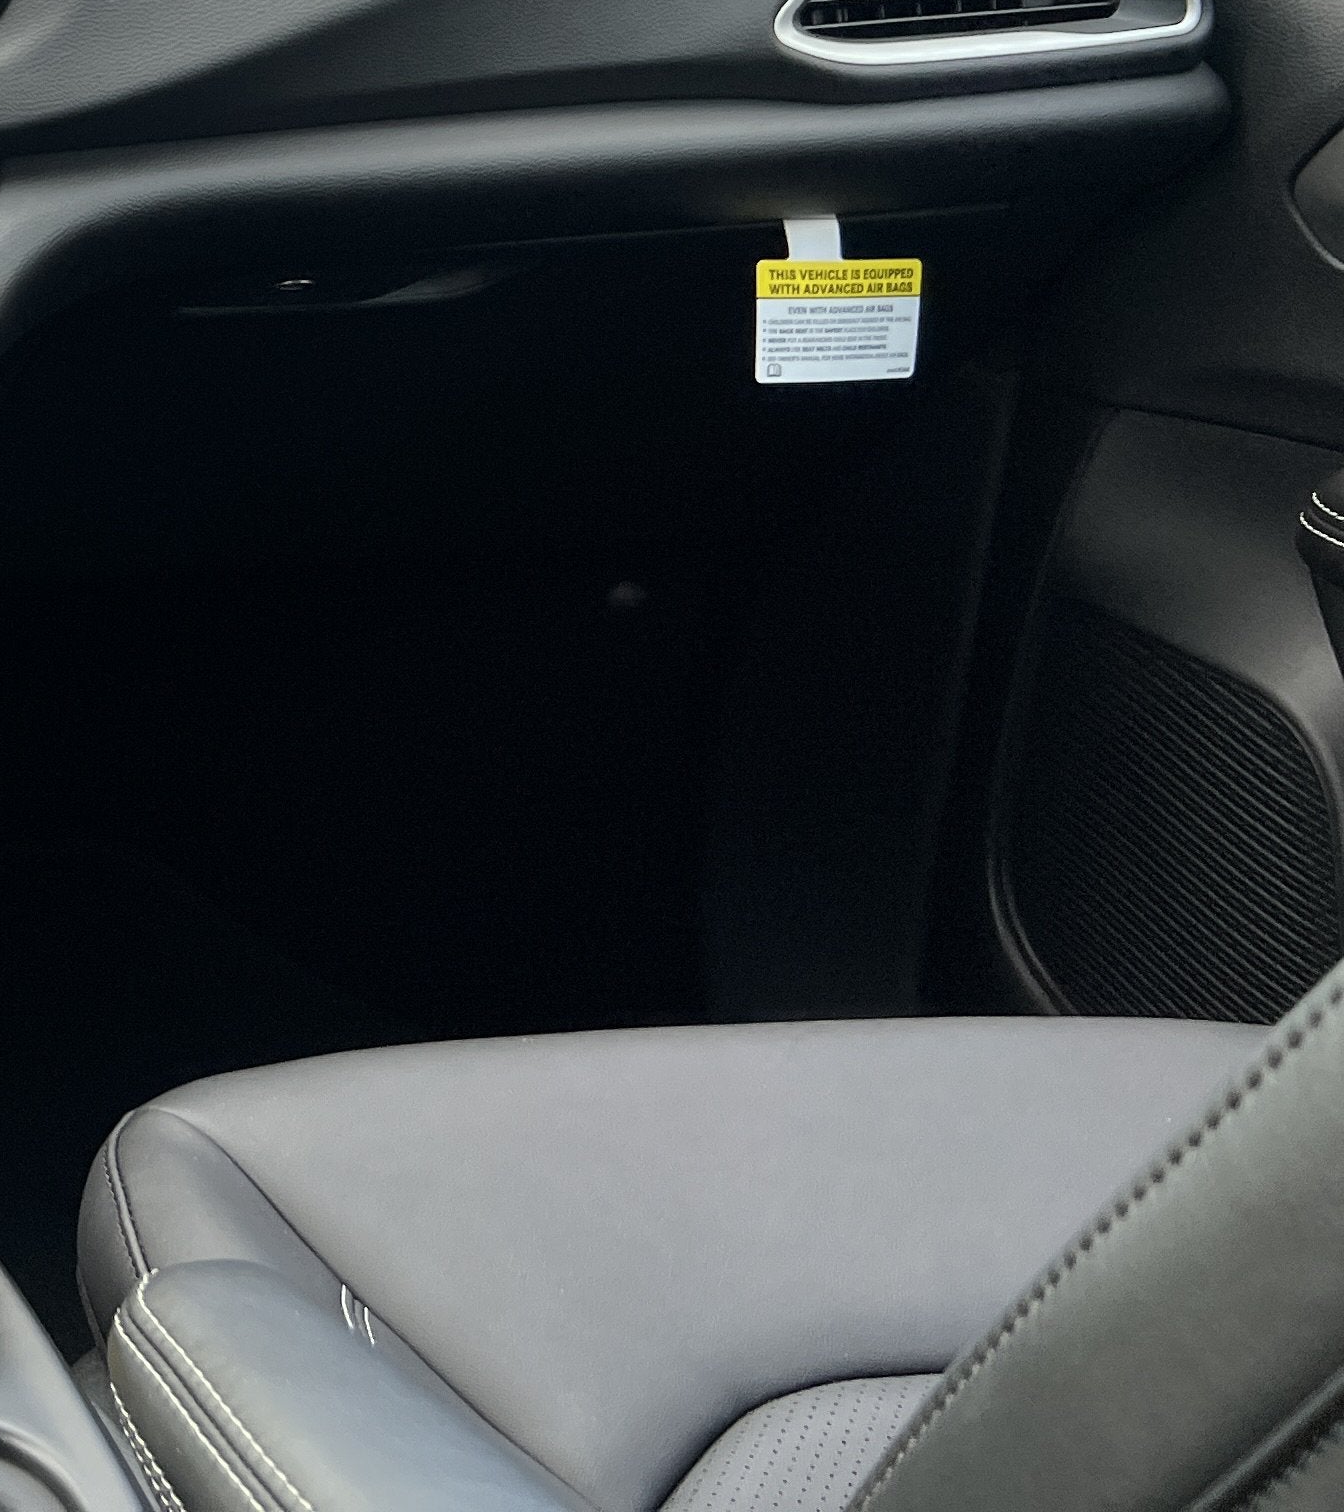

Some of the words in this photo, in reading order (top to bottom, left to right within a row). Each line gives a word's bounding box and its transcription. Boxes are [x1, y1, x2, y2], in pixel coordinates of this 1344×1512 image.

[769, 269, 797, 281] THIS
[800, 269, 848, 281] VEHICLE
[850, 269, 861, 280] IS
[863, 268, 914, 280] EQUIPPED
[769, 283, 800, 295] WITH
[804, 283, 864, 295] ADVANCED
[866, 282, 883, 294] AIR
[886, 281, 913, 293] BAGS
